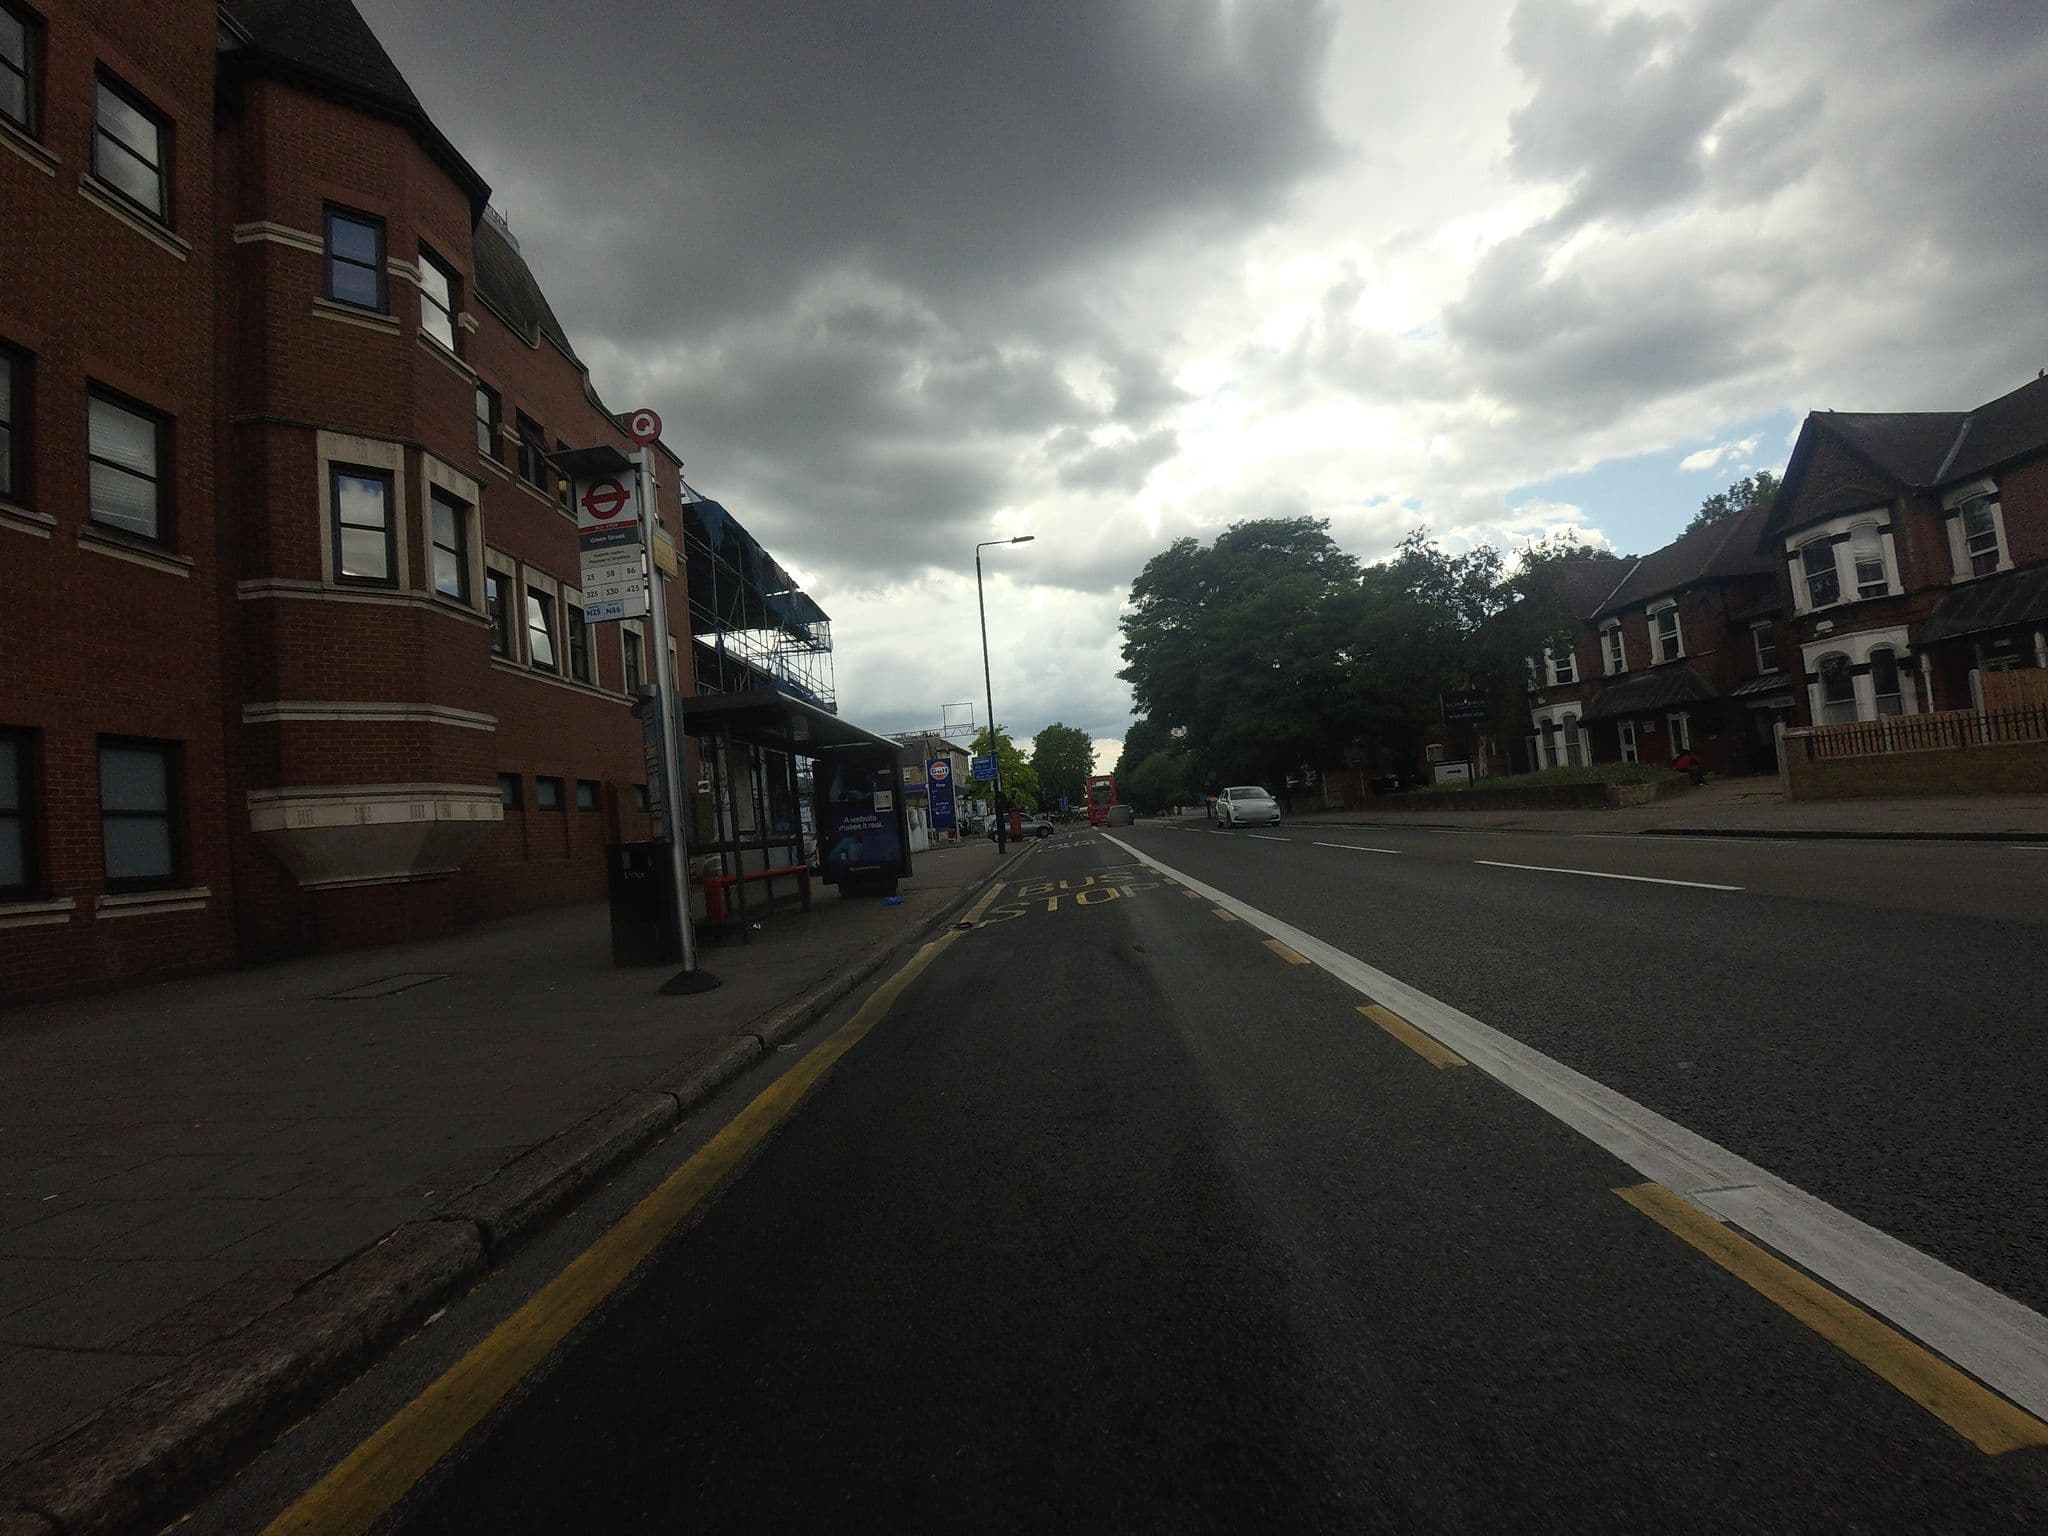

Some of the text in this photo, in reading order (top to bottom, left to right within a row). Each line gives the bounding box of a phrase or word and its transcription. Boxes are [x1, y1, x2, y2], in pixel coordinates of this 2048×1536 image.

[632, 413, 655, 436] Q
[586, 573, 595, 581] 25
[1018, 872, 1135, 897] BUS
[985, 882, 1160, 924] STOP
